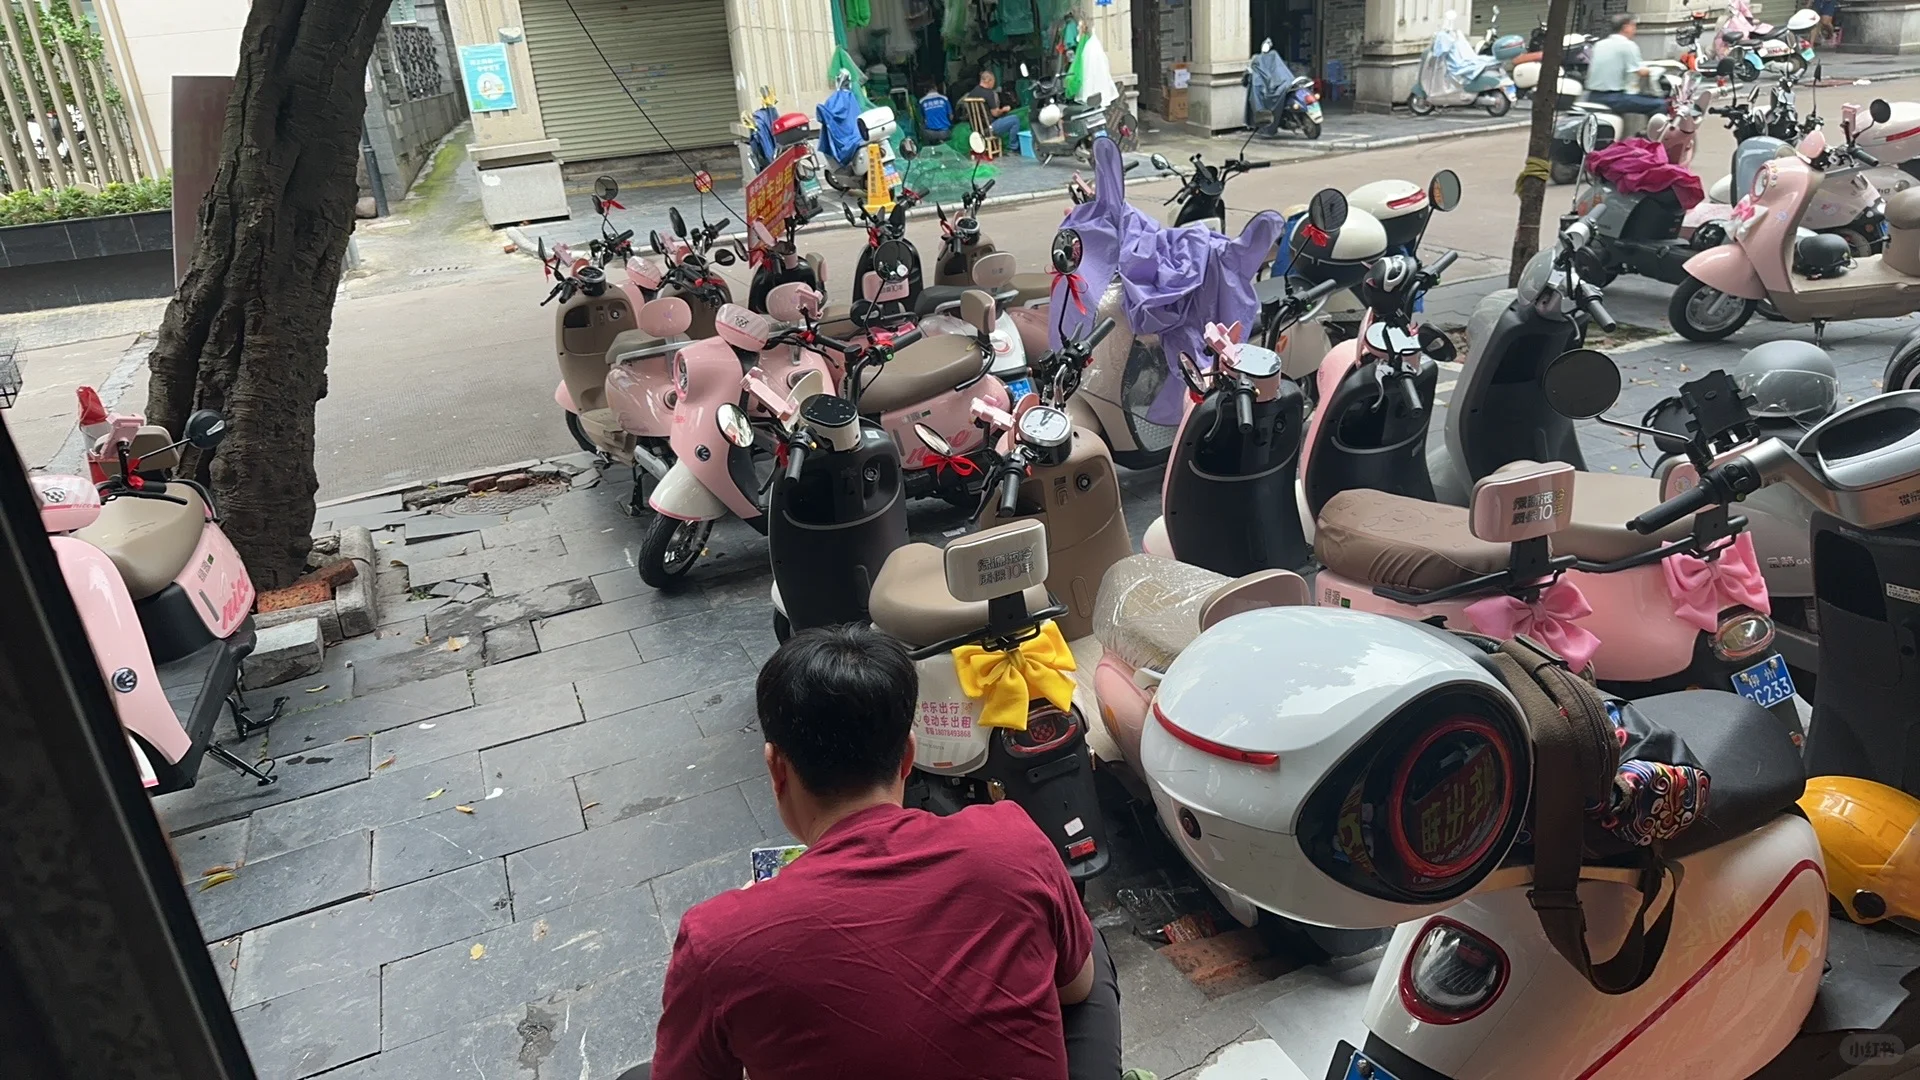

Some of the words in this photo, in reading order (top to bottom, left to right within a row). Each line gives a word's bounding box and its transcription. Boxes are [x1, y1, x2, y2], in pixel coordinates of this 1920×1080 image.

[748, 164, 793, 217] 电动车出租
[1748, 667, 1778, 689] 柳州
[922, 701, 959, 714] 快乐出行
[924, 714, 971, 728] 电动车出租
